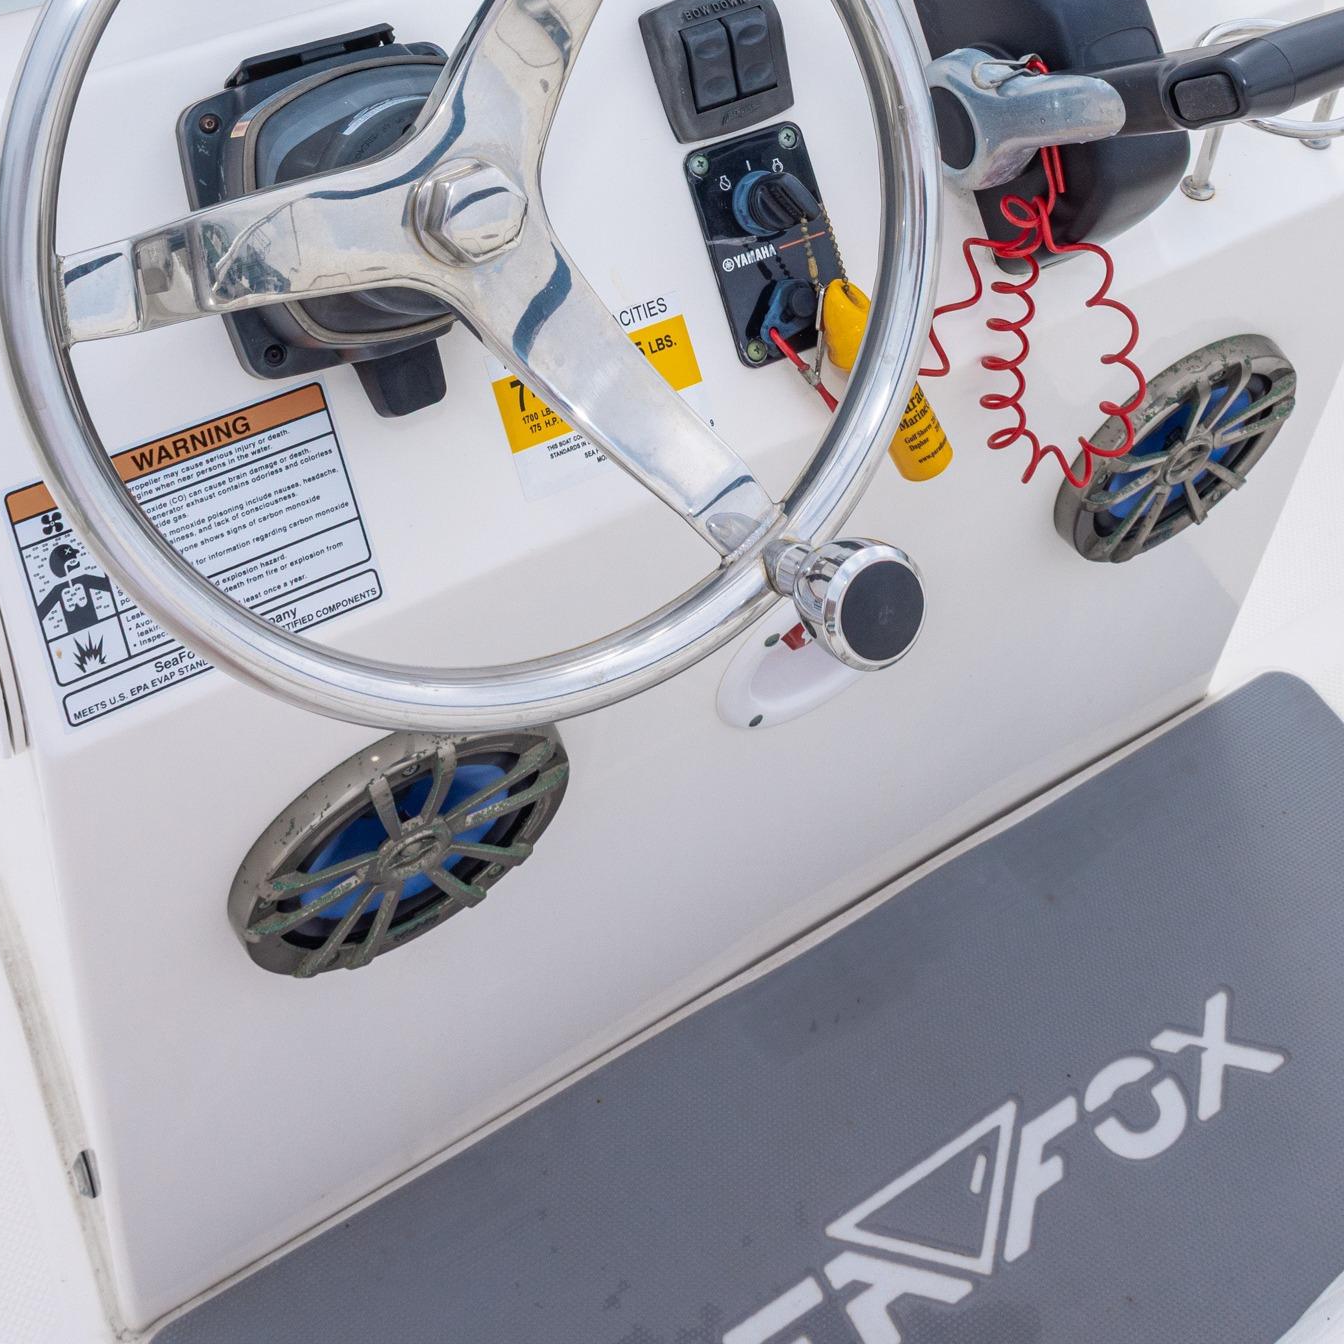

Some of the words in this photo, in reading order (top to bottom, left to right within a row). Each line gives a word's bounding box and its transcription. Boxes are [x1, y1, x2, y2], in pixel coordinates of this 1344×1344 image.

[683, 5, 710, 20] BOW
[733, 244, 776, 268] YAMAHA
[613, 297, 668, 327] CITIES
[648, 334, 678, 354] LBS.
[522, 412, 538, 424] 1700
[529, 423, 542, 434] 175
[544, 418, 560, 428] H.P.
[131, 416, 251, 472] WARNING
[164, 470, 179, 482] may
[181, 460, 204, 474] cause
[206, 450, 234, 464] serious
[235, 442, 256, 454] injury
[268, 430, 290, 440] death.
[547, 444, 558, 452] THIS
[559, 438, 572, 448] BOAT
[550, 443, 581, 459] STANDARDS
[146, 502, 168, 514] oxide
[169, 493, 187, 506] (CO)
[188, 488, 202, 498] can
[204, 480, 226, 492] cause
[228, 472, 248, 482] brain
[249, 459, 278, 475] damage
[280, 456, 287, 464] or
[289, 448, 312, 460] death.
[155, 481, 176, 492] when
[178, 474, 194, 484] near
[196, 462, 226, 478] persons
[228, 456, 236, 465] in
[237, 452, 250, 462] the
[251, 444, 273, 456] water.
[150, 504, 184, 520] enerator
[186, 492, 216, 508] exhaust
[218, 480, 250, 496] contains
[251, 467, 283, 483] odorless
[284, 460, 298, 471] and
[300, 448, 333, 465] colorless
[169, 518, 206, 536] monoxide
[208, 503, 244, 522] poisoning
[246, 492, 272, 506] include
[180, 543, 198, 555] yone
[200, 532, 224, 546] shows
[226, 523, 247, 536] signs
[248, 518, 256, 527] of
[258, 510, 284, 523] carbon
[285, 494, 320, 512] monoxide
[198, 524, 213, 534] and
[214, 516, 230, 528] lack
[232, 512, 240, 520] of
[196, 557, 207, 566] for
[208, 540, 251, 560] information
[252, 526, 288, 543] regarding
[288, 514, 314, 529] carbon
[316, 501, 349, 519] monoxide
[222, 564, 258, 584] explosion
[260, 554, 287, 568] hazard.
[224, 580, 245, 593] death
[246, 572, 264, 584] from
[266, 565, 278, 576] fire
[280, 563, 288, 571] or
[290, 548, 325, 567] explosion
[326, 541, 344, 552] from
[244, 592, 262, 604] least
[264, 584, 282, 595] once
[290, 574, 308, 586] year.
[126, 612, 146, 623] Leak
[73, 701, 108, 721] MEETS
[109, 694, 128, 706] U.S.
[130, 683, 150, 697] EPA
[151, 671, 176, 688] EVAP
[284, 614, 314, 632] TIFIED
[315, 587, 378, 618] COMPONENTS
[140, 632, 169, 646] Inspec
[155, 650, 196, 673] SeaFo
